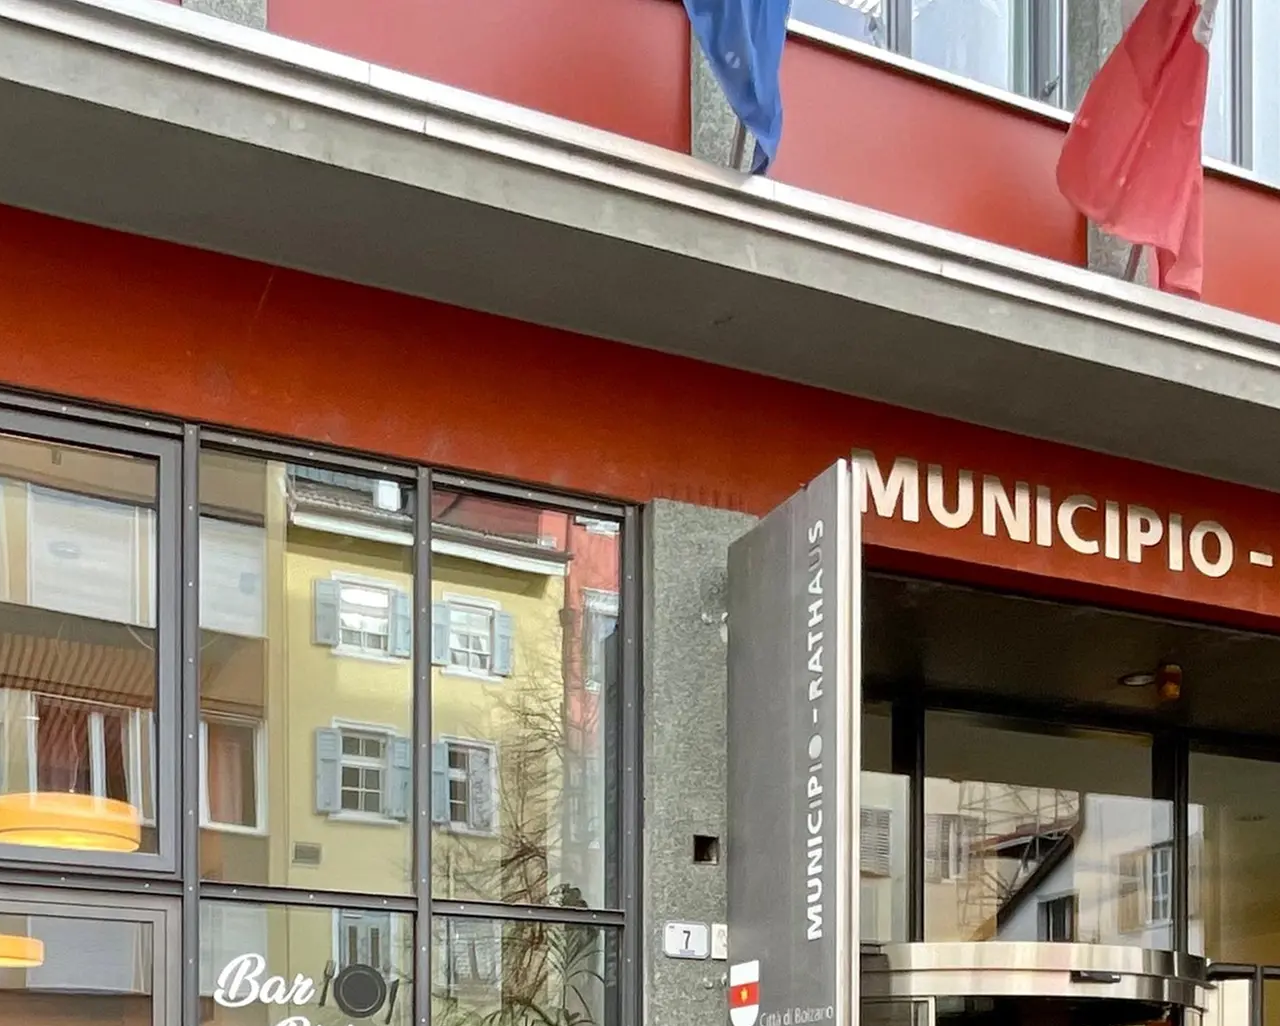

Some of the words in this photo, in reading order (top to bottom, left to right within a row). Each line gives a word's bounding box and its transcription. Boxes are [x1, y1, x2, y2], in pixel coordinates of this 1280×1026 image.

[851, 447, 1234, 578] MUNICIPIO
[808, 519, 824, 702] RATHAUS
[807, 733, 824, 941] MUNICIPIO
[213, 953, 316, 1008] Bar
[682, 929, 692, 951] 7
